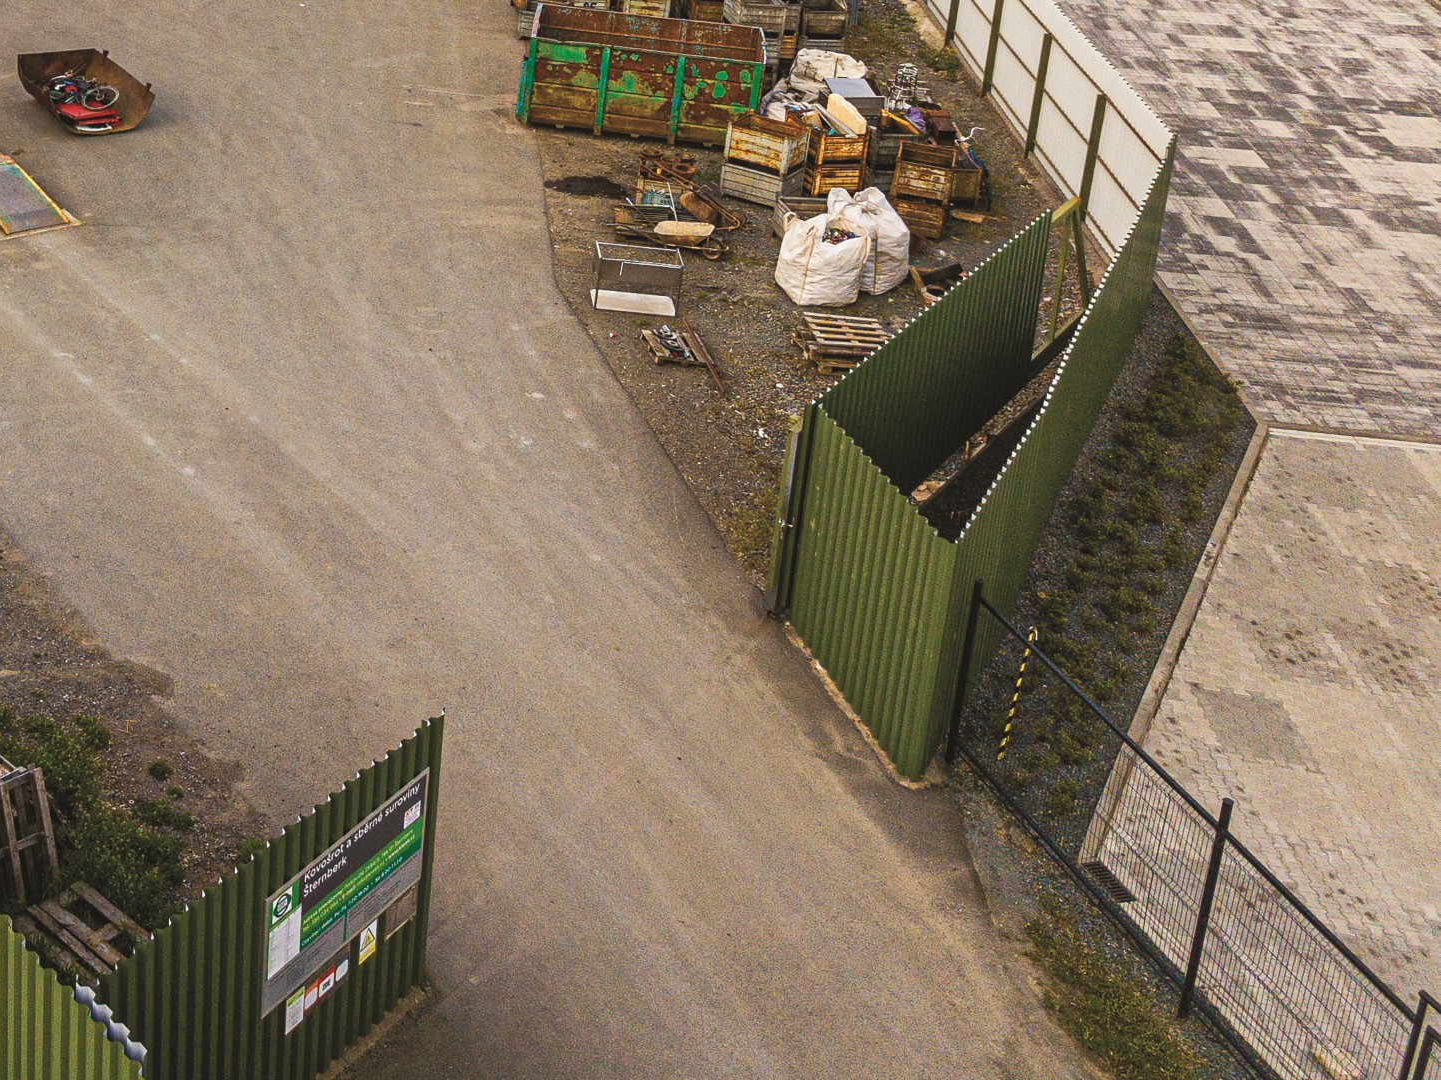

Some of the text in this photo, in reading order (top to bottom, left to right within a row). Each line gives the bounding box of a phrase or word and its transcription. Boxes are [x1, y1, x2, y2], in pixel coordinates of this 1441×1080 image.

[304, 842, 344, 883] Kovošrot
[346, 838, 352, 848] a
[353, 811, 383, 842] sběrné
[385, 783, 420, 817] suroviny
[303, 856, 347, 897] Šternberk
